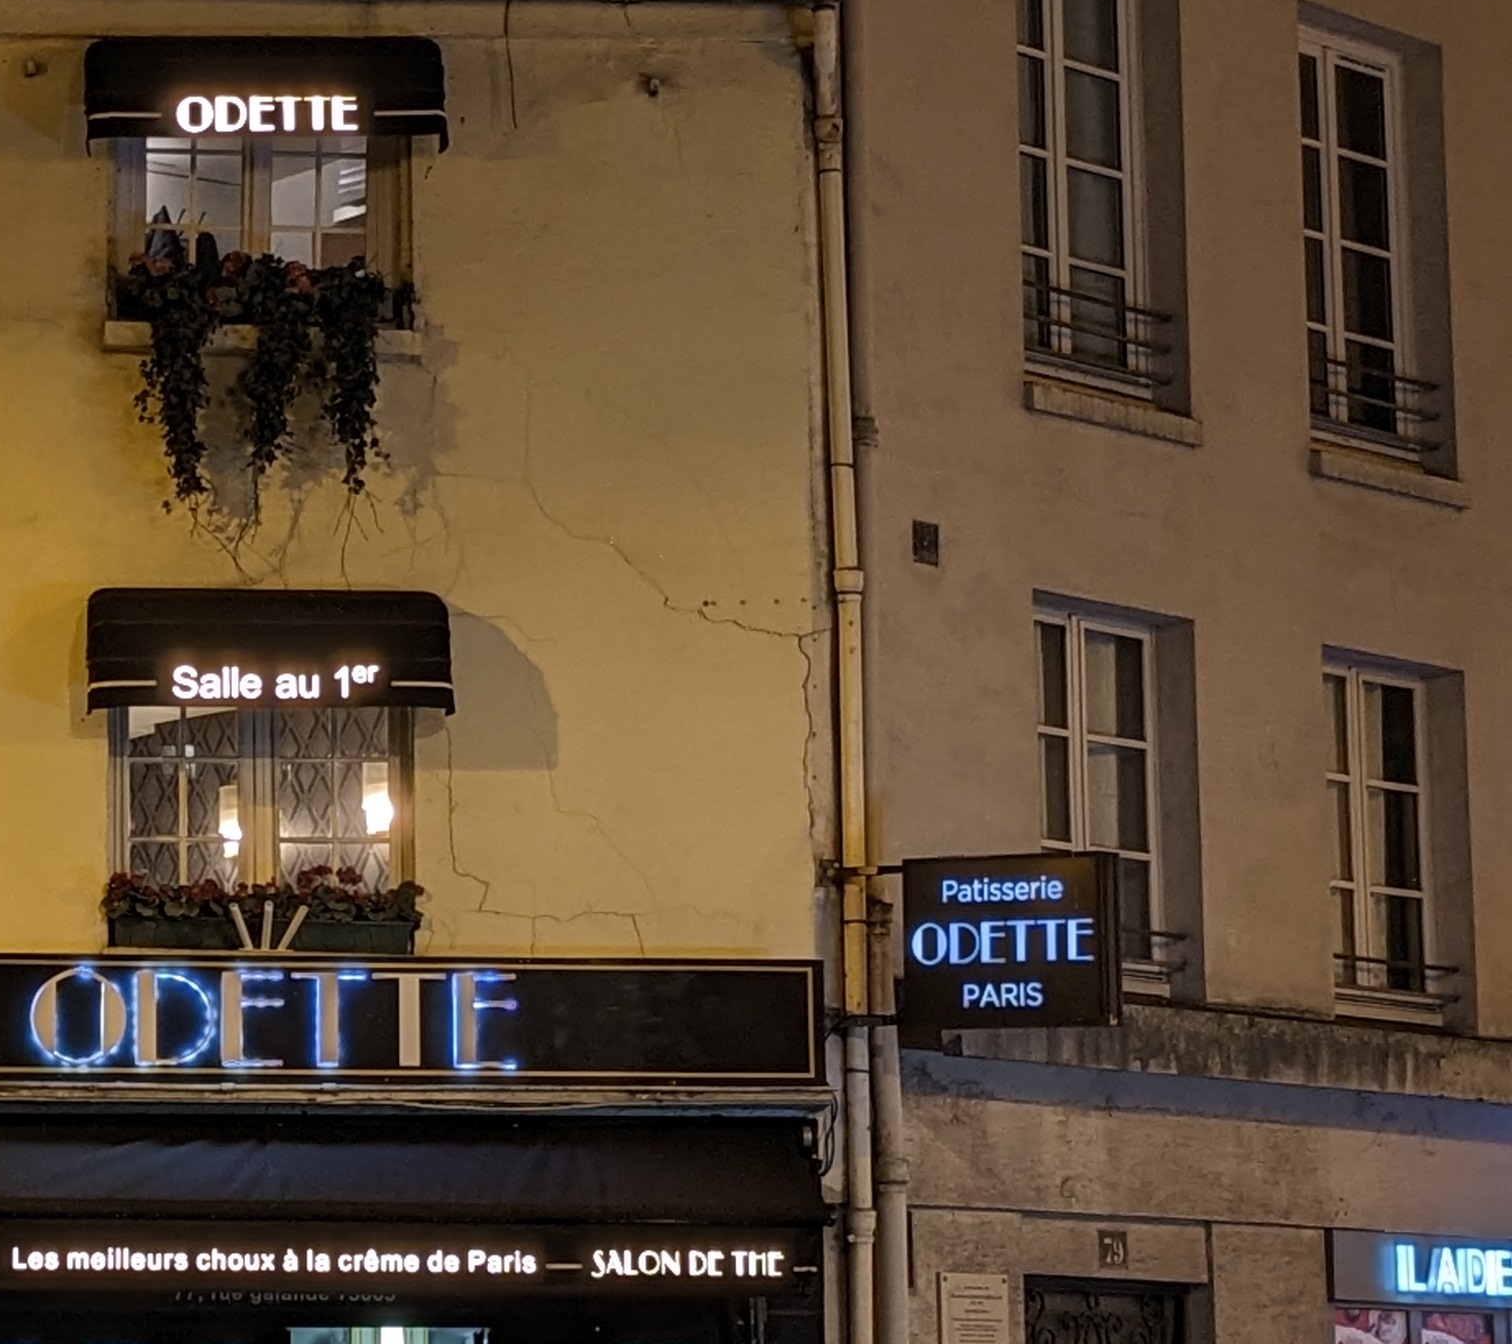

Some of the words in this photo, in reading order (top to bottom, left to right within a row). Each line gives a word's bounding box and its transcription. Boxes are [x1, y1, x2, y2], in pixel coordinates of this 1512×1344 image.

[175, 95, 359, 134] ODETTE
[172, 665, 263, 699] Salle
[275, 672, 320, 699] au
[333, 664, 380, 699] 1er
[942, 875, 1064, 904] Patisserie
[911, 918, 1095, 966] ODETTE
[962, 981, 1044, 1008] PARIS
[31, 966, 518, 1070] ODETTE
[12, 1246, 60, 1271] Les
[66, 1247, 189, 1271] meilleurs
[196, 1248, 275, 1271] choux
[282, 1248, 299, 1272] à
[306, 1248, 331, 1272] la
[426, 1249, 460, 1273] de
[467, 1249, 537, 1274] Paris
[590, 1249, 681, 1278] SALON
[688, 1250, 725, 1276] DE
[1103, 1236, 1125, 1264] 79
